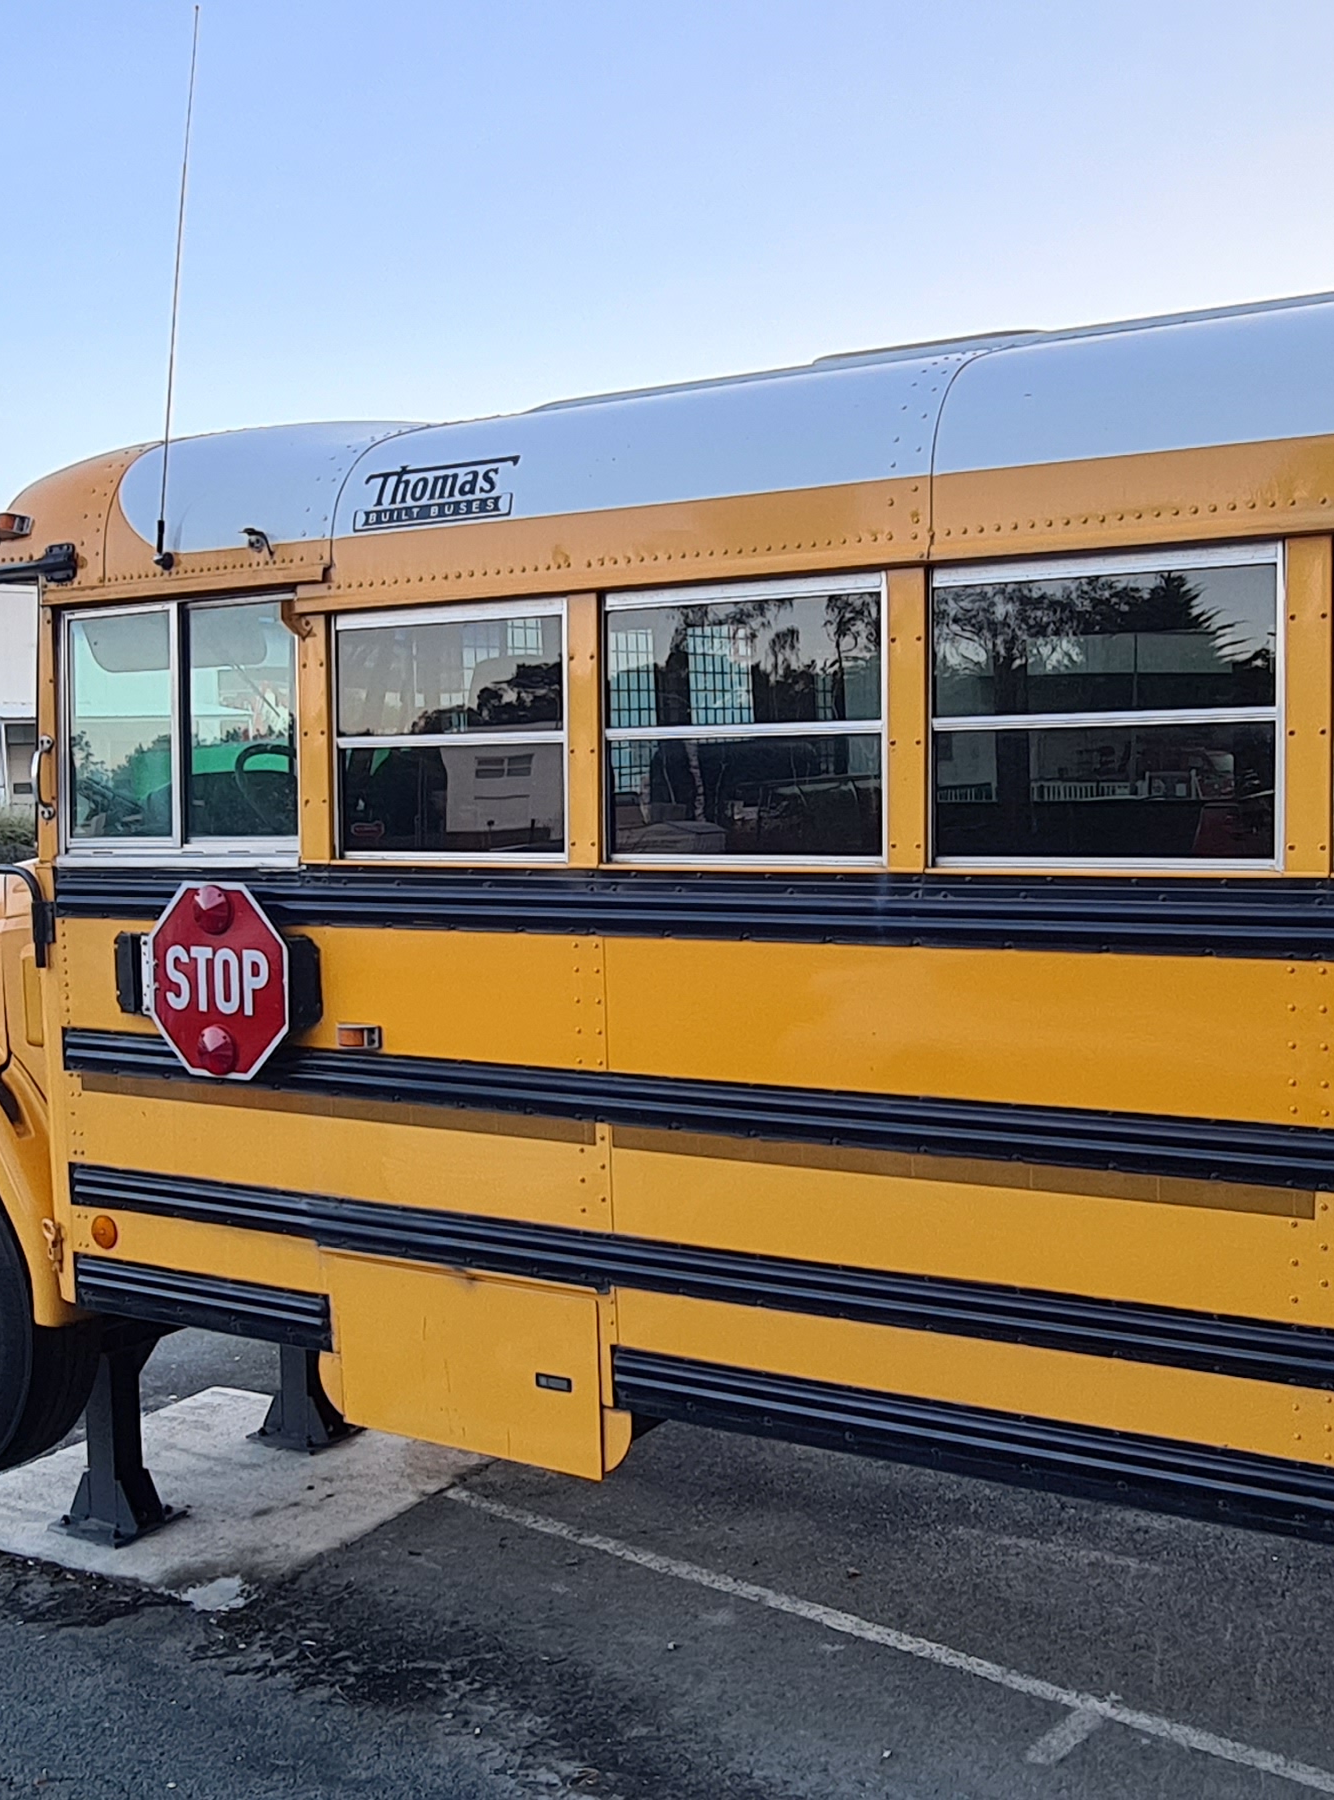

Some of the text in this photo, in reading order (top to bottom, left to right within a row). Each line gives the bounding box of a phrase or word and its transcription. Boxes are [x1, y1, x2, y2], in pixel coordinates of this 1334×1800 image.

[364, 455, 521, 507] Thomas
[368, 499, 495, 524] BUILT BUSES
[165, 944, 269, 1016] STOP
